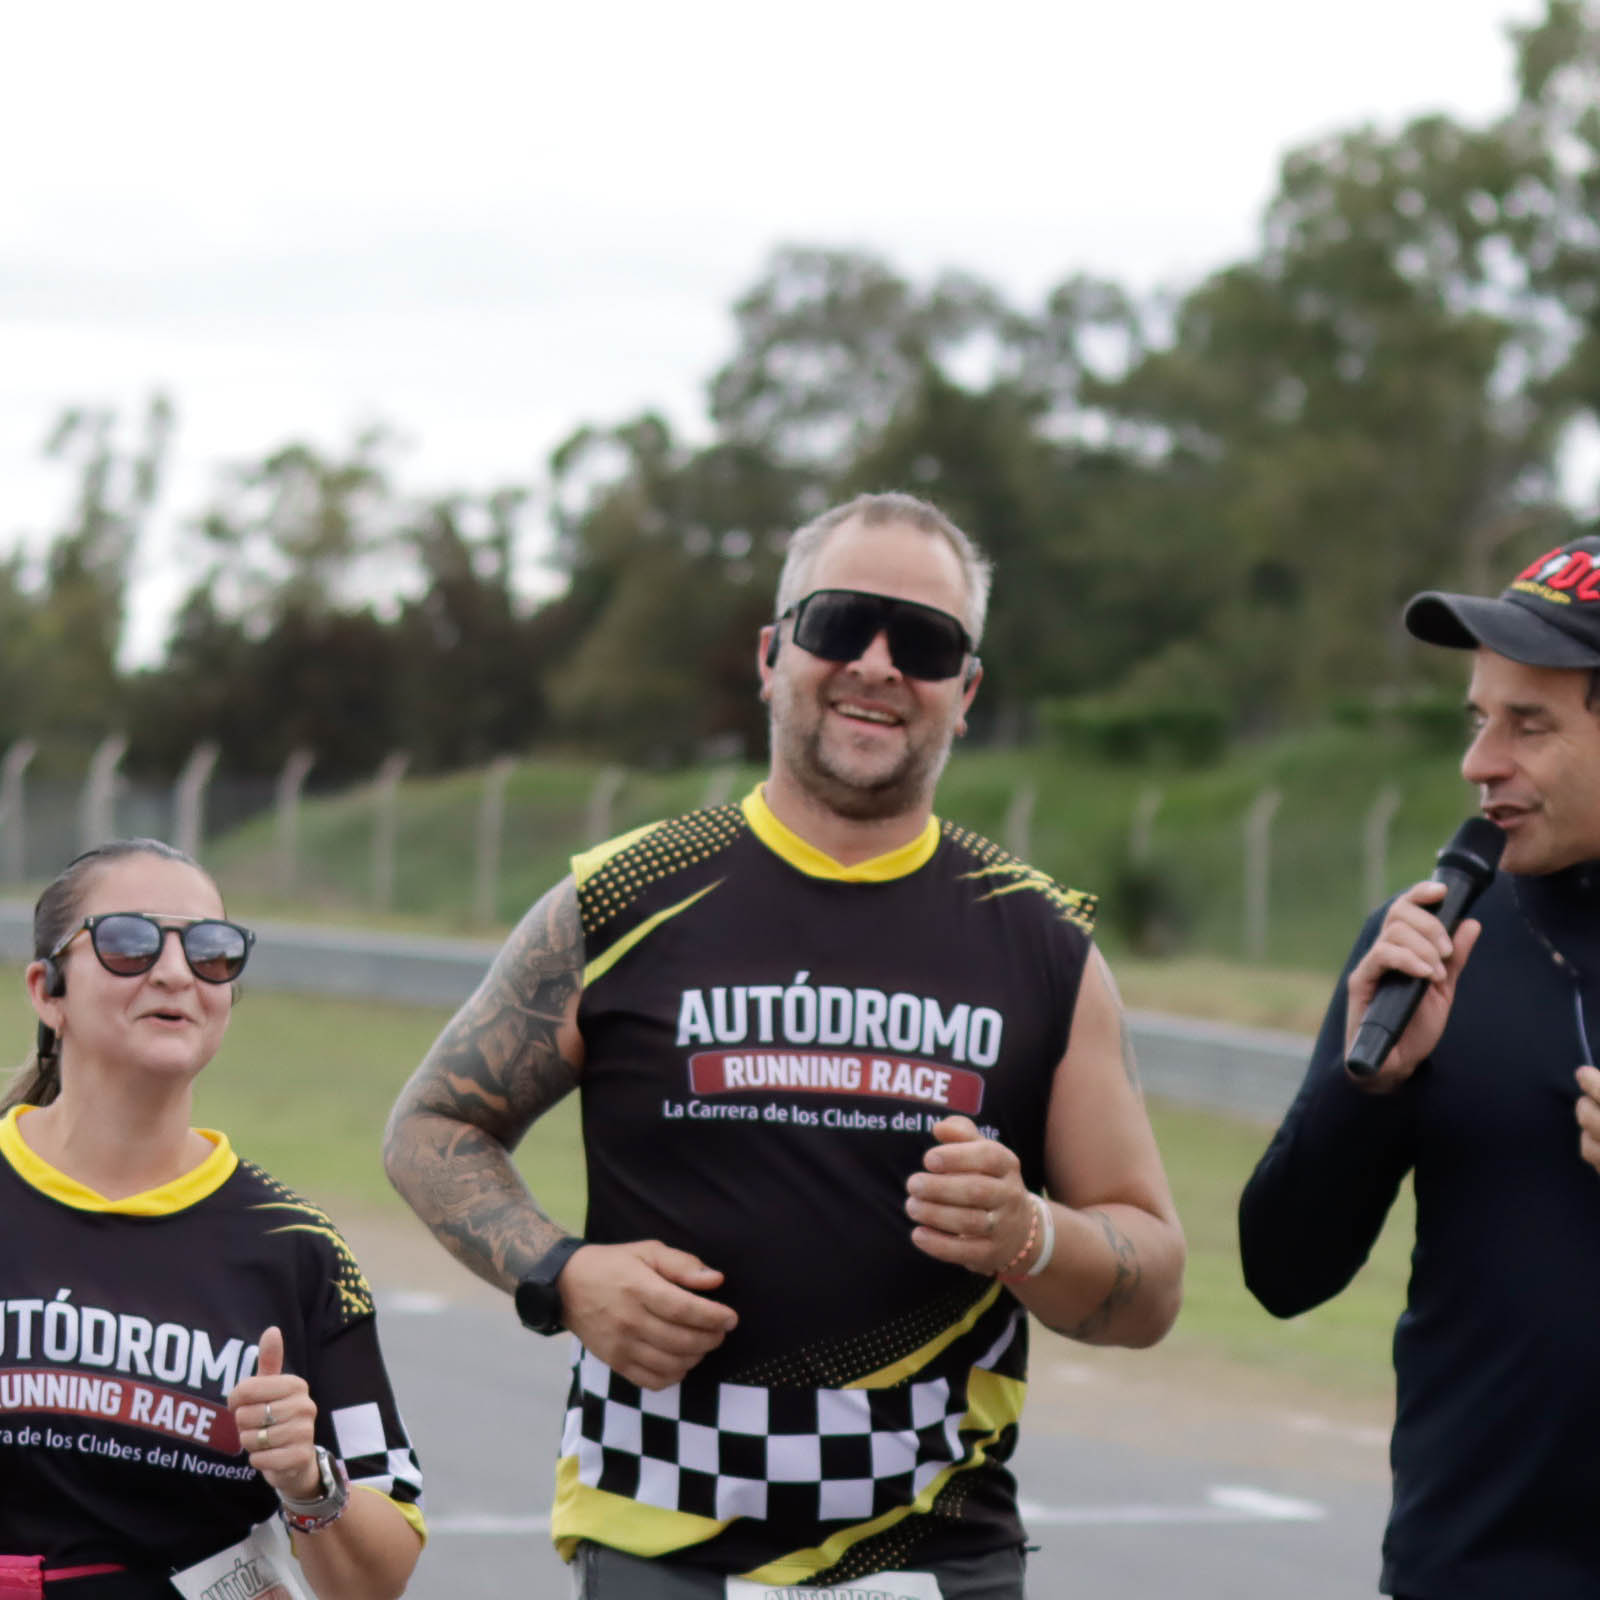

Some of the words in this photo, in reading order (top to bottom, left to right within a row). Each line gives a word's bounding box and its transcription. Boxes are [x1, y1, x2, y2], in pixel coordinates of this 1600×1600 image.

[676, 971, 1003, 1068] AUTÓDROMO
[722, 1055, 861, 1090] RUNNING
[869, 1059, 952, 1104] RACE
[663, 1099, 684, 1118] La
[687, 1100, 759, 1119] Carrera
[763, 1102, 788, 1121] de
[791, 1104, 819, 1125] los
[823, 1108, 887, 1129] Clubes
[891, 1111, 922, 1131] del
[129, 1387, 217, 1444] RACE
[17, 1425, 42, 1445] de
[46, 1428, 73, 1449] los
[77, 1433, 142, 1461] Clubes
[146, 1446, 179, 1469] del
[182, 1452, 257, 1481] Noroeste
